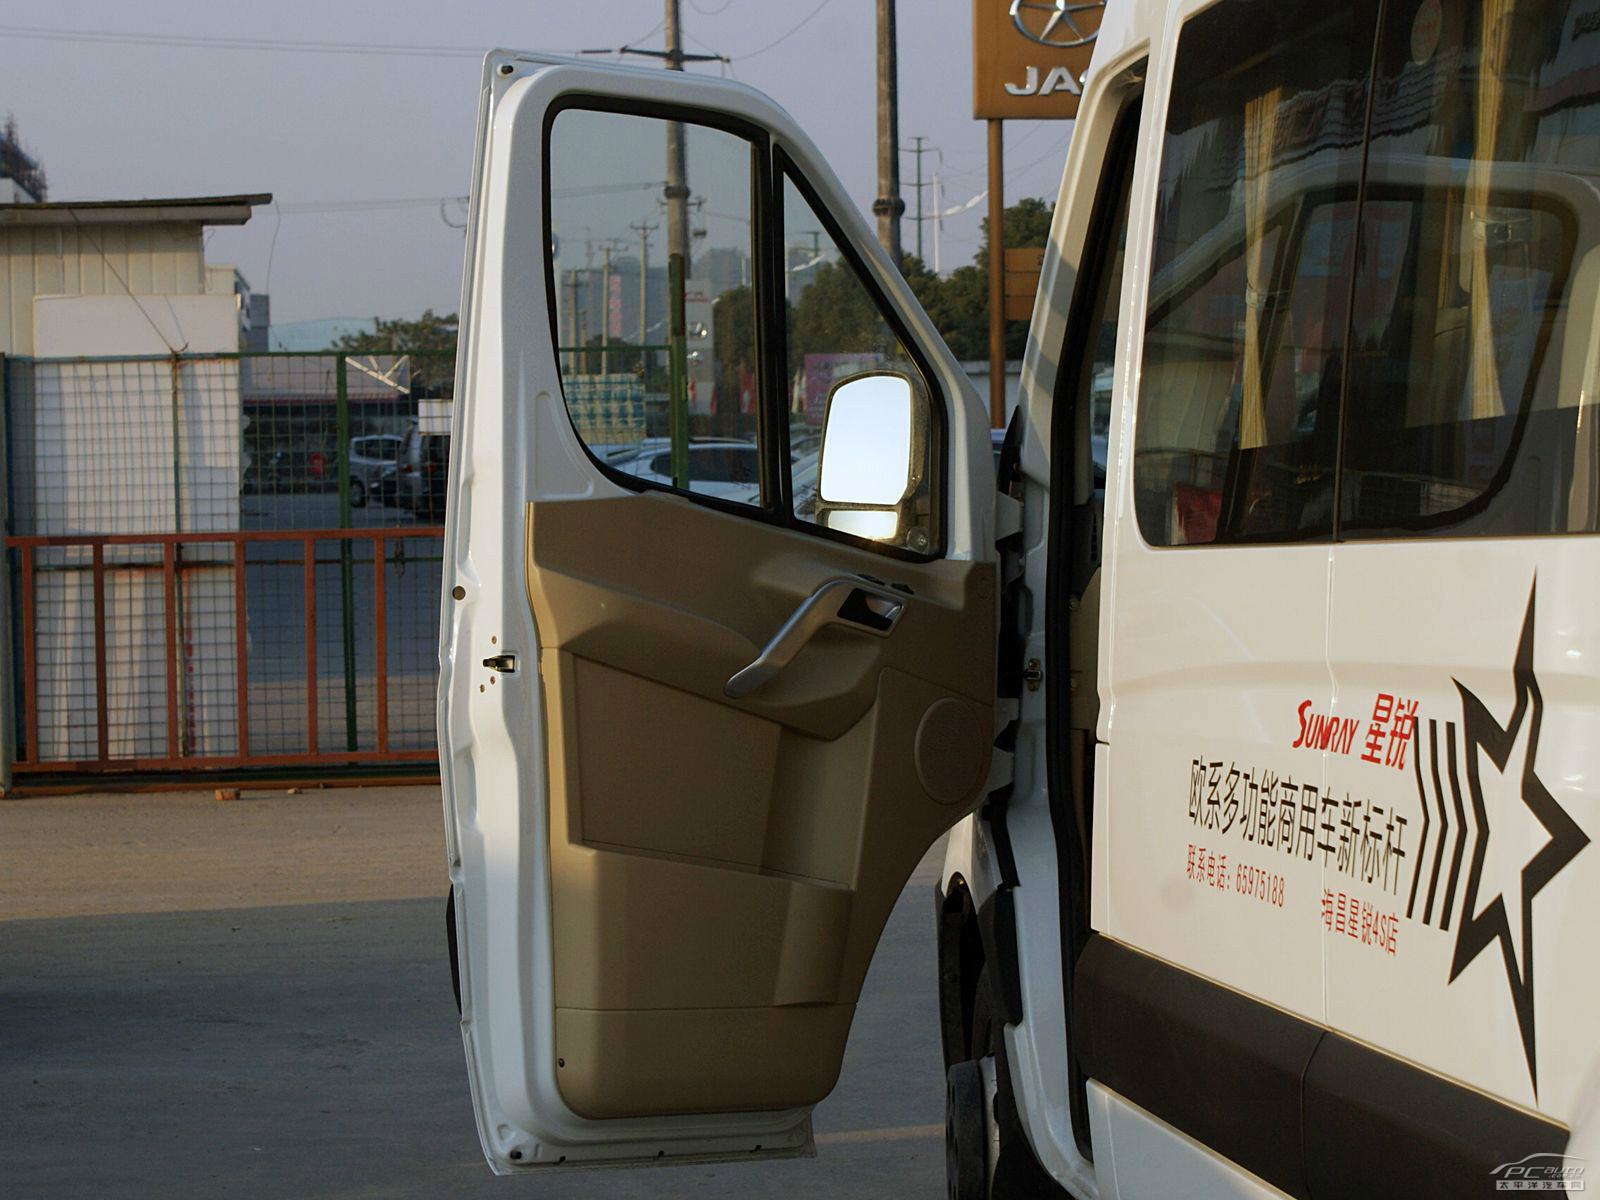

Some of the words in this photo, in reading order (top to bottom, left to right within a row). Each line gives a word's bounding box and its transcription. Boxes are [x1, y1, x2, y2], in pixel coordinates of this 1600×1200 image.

[1004, 66, 1089, 96] JA
[1361, 693, 1418, 770] 星锐
[1188, 755, 1407, 895] 欧系多功能商用车新标杆
